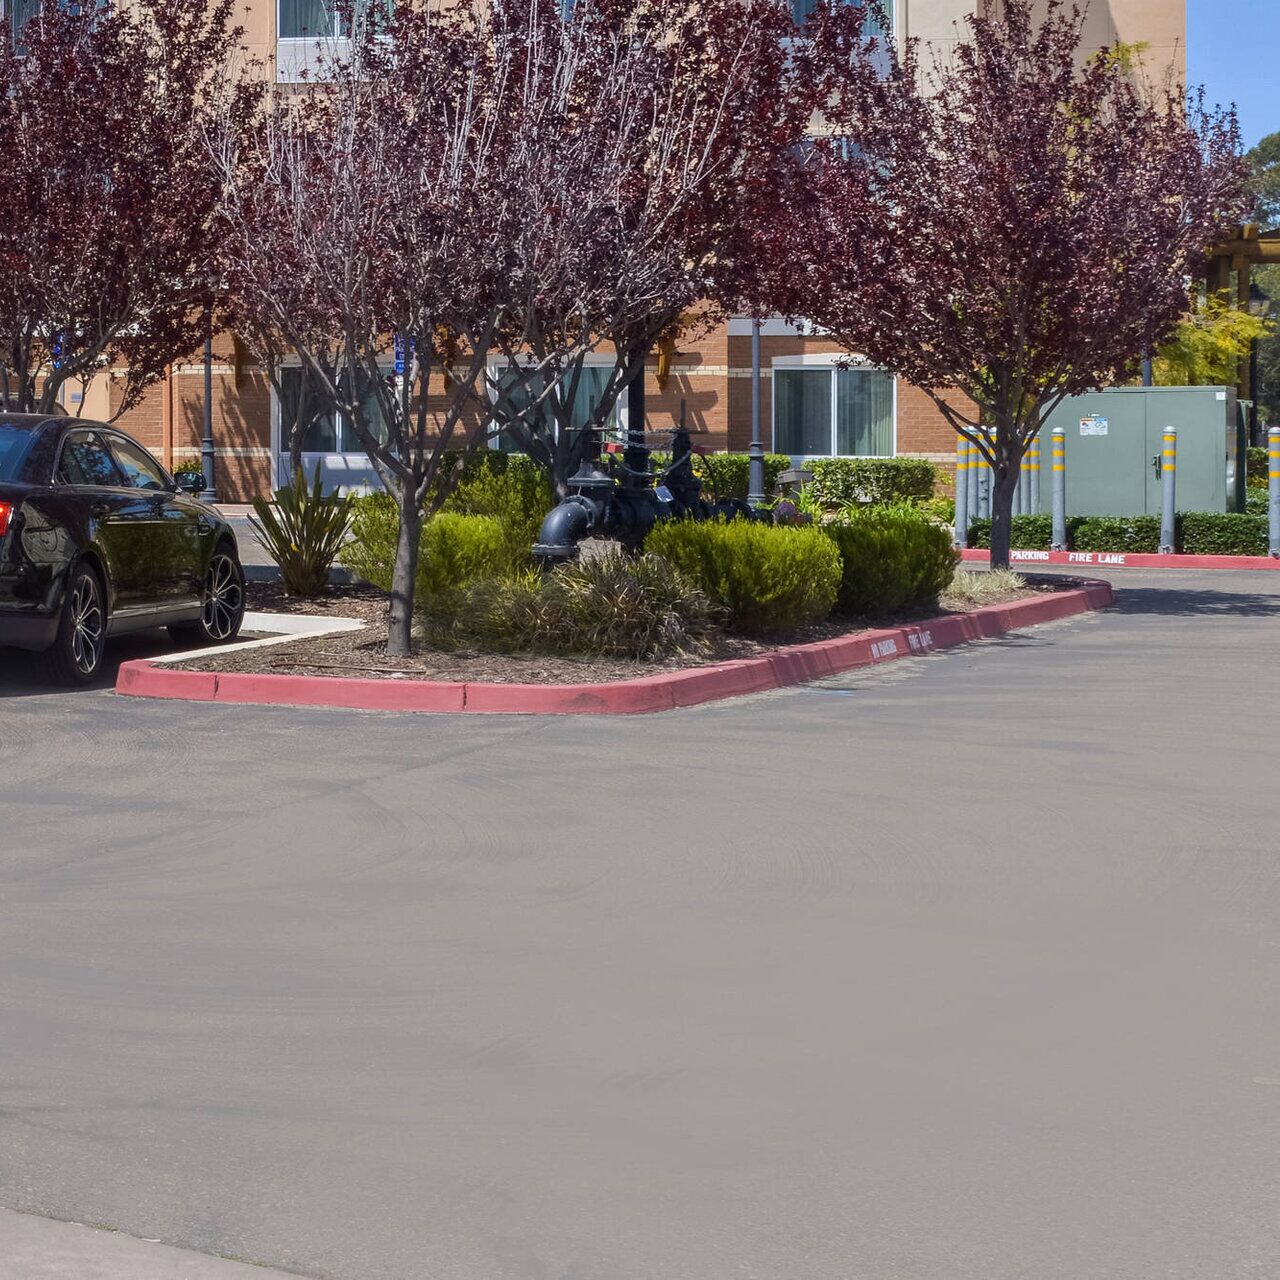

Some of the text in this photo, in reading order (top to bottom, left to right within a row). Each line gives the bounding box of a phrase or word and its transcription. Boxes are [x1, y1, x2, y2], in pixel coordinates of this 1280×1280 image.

[1011, 551, 1126, 564] PARKING FIRE LANE
